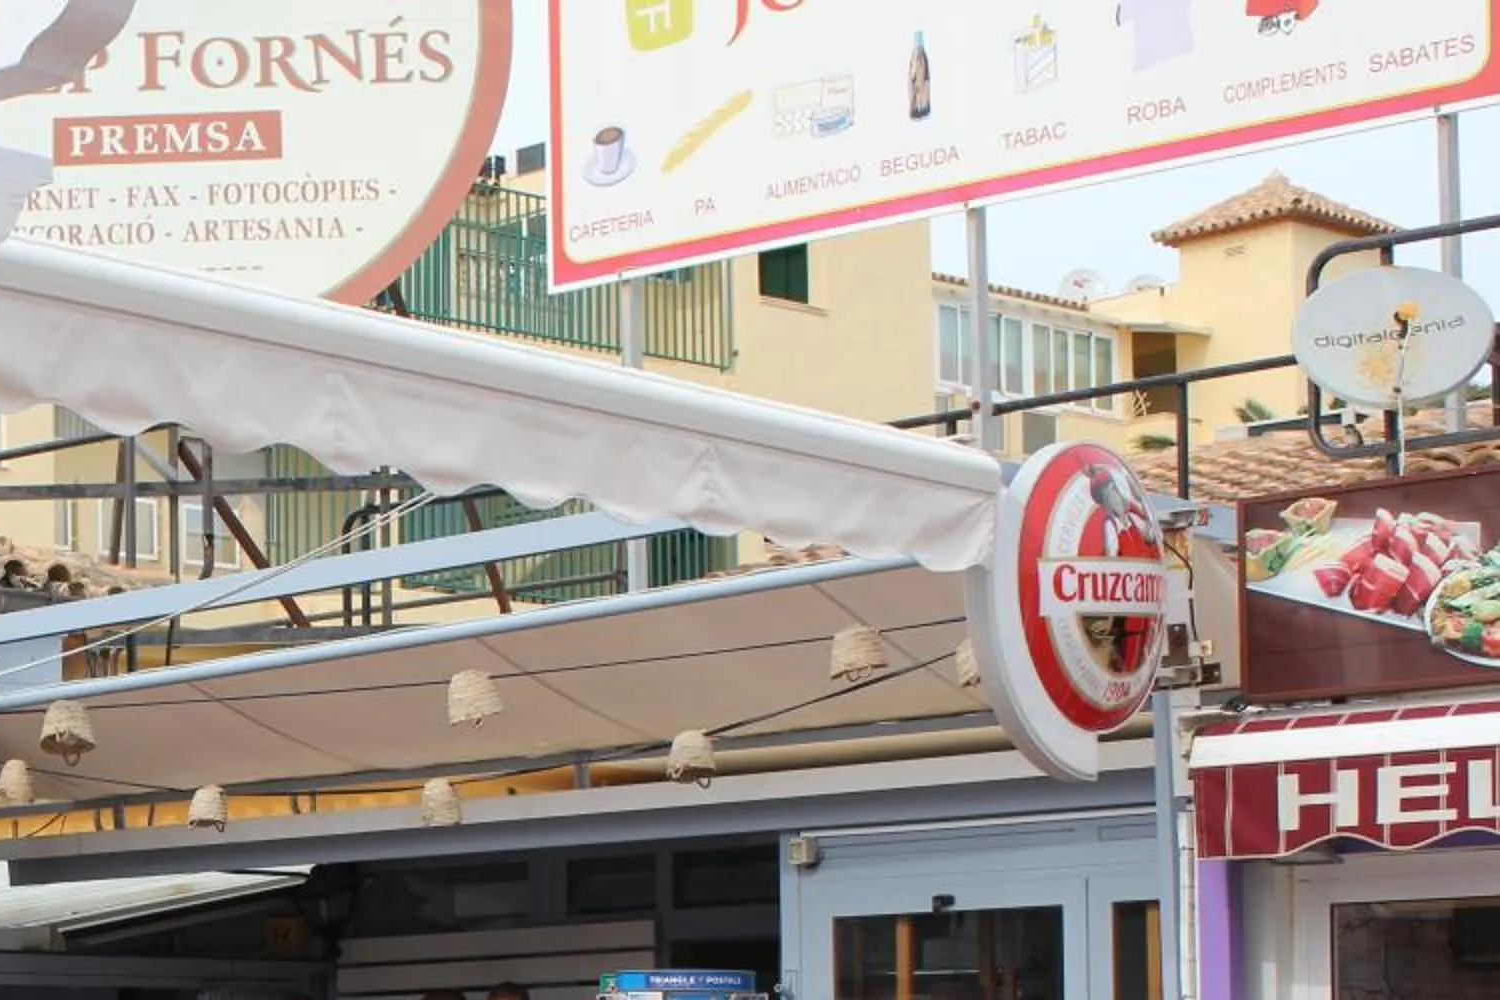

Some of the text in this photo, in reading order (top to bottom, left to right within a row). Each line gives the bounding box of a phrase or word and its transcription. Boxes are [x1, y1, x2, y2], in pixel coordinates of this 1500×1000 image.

[136, 16, 455, 93] FORNÉS
[1369, 34, 1475, 73] SABATES
[1223, 62, 1348, 103] COMPLEMENTS
[1127, 97, 1187, 125] ROBA
[69, 119, 266, 158] PREMSA
[1002, 122, 1067, 149] TABAC
[880, 146, 960, 177] BEGUDA
[25, 187, 101, 212] RNET
[127, 184, 181, 208] FAX
[207, 172, 381, 207] FOTOCÒPIES
[694, 198, 716, 216] PA
[13, 213, 156, 246] CORACIÓ
[183, 216, 344, 244] ARTESANIA
[569, 210, 654, 242] CAFETERIA
[1053, 564, 1164, 602] Cruzcam
